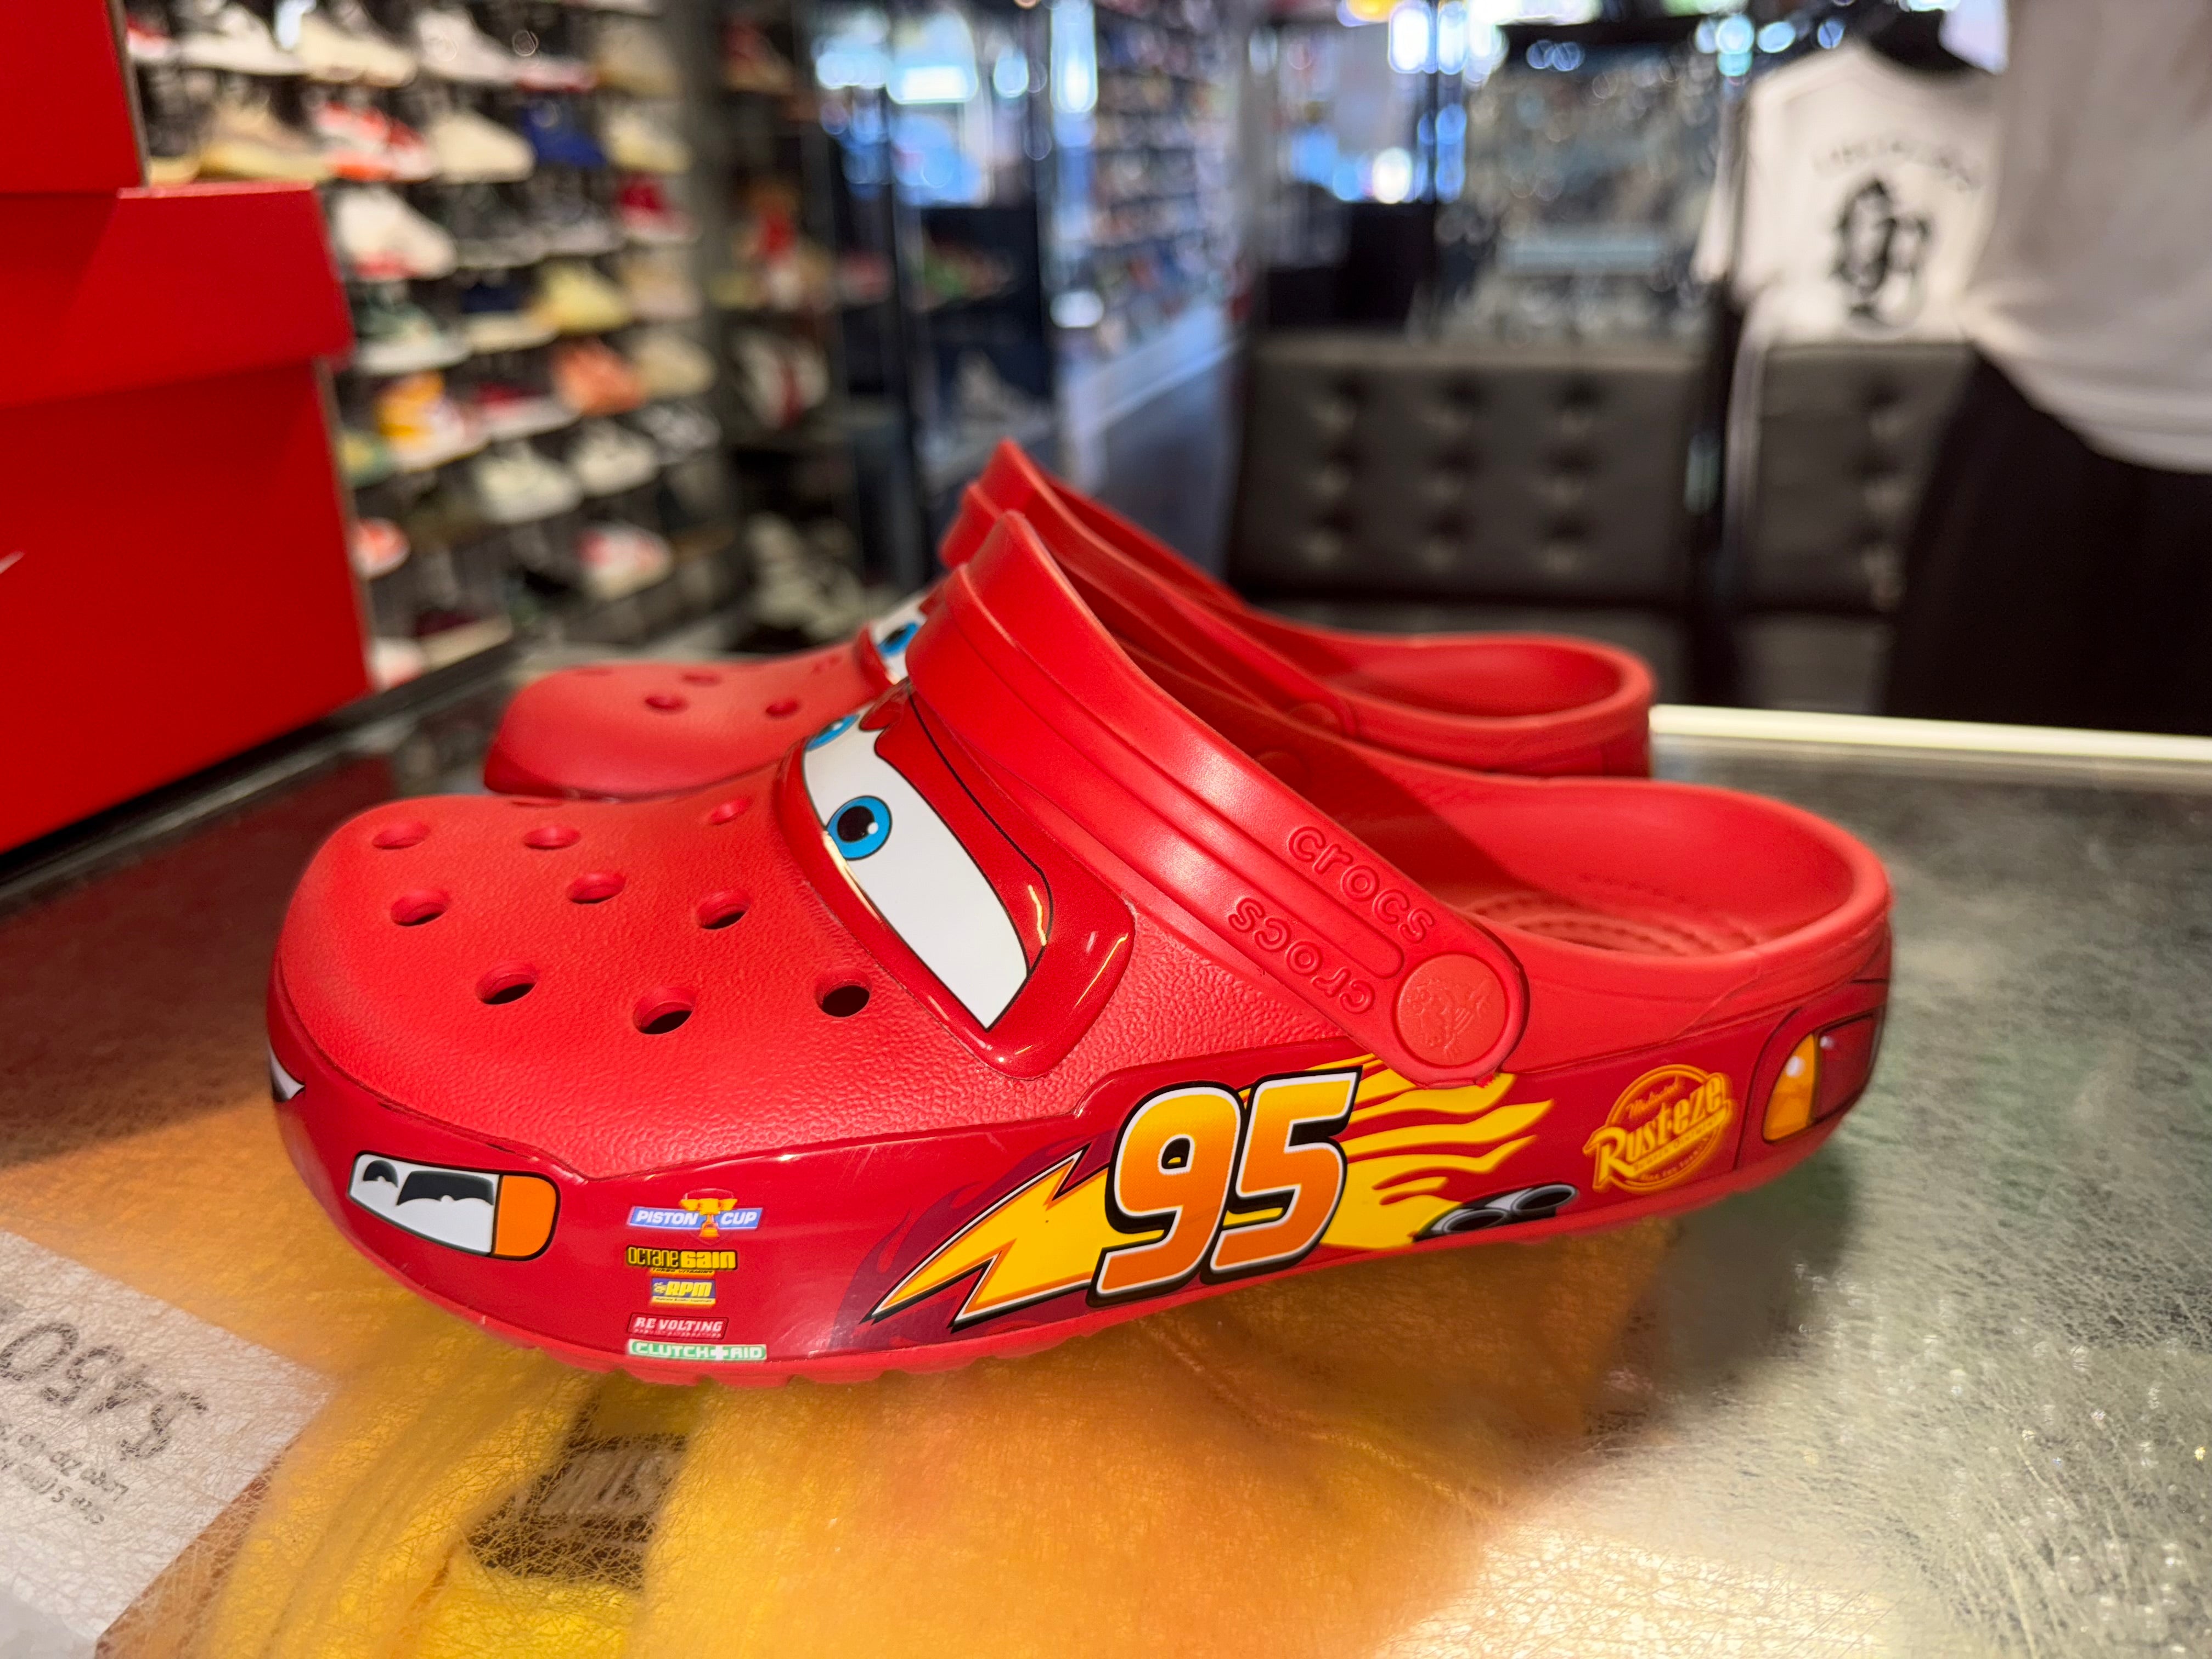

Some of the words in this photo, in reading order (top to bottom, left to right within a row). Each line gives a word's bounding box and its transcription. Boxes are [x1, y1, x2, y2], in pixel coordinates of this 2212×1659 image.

[1288, 826, 1436, 944] crocs
[1228, 896, 1375, 1014] crocs
[635, 1210, 698, 1226] PISTON
[720, 1211, 758, 1225] CUP
[1088, 1066, 1362, 1306] 95
[665, 1281, 712, 1297] RPM
[634, 1317, 657, 1328] RE
[659, 1319, 723, 1332] VOLTING
